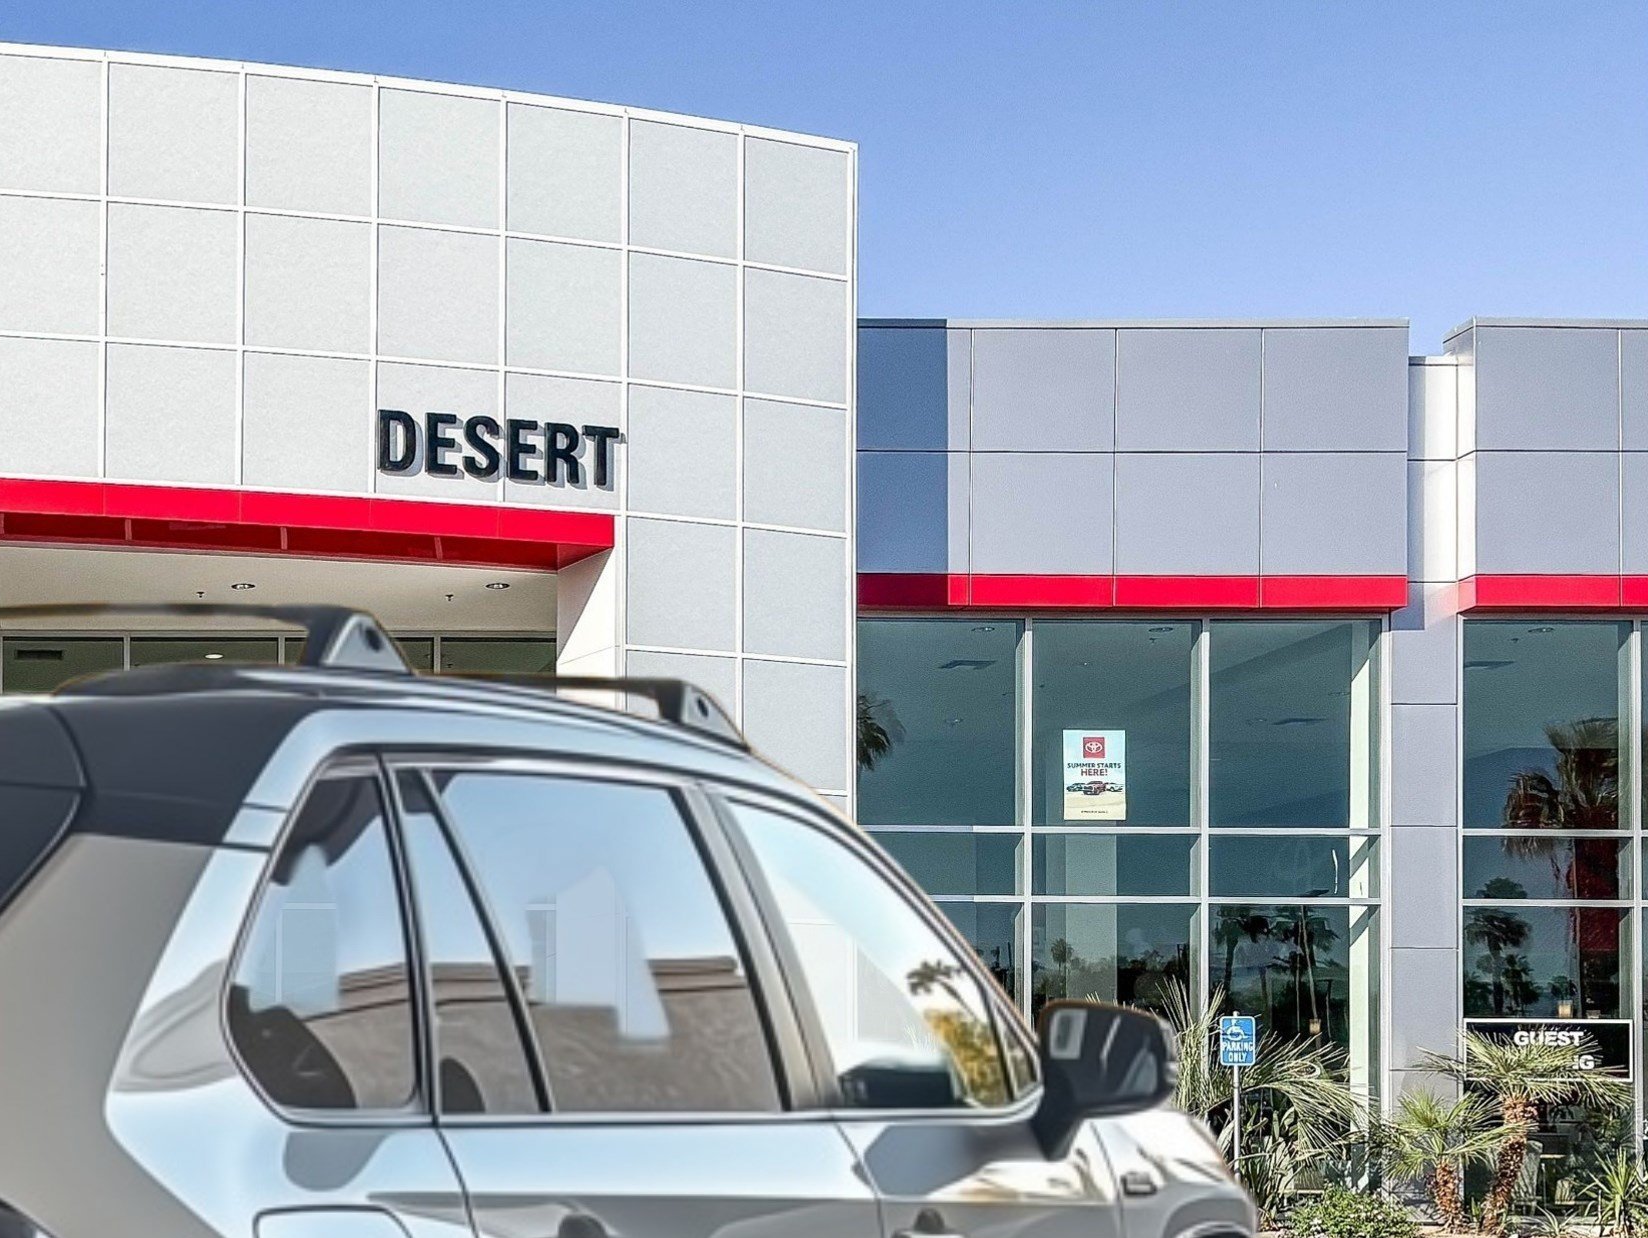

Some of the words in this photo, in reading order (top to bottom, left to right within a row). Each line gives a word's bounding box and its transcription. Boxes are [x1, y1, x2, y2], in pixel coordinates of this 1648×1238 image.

[376, 408, 621, 487] DESERT
[1513, 1031, 1584, 1047] GUEST
[1221, 1041, 1254, 1051] PARKING
[1228, 1052, 1248, 1063] ONLY
